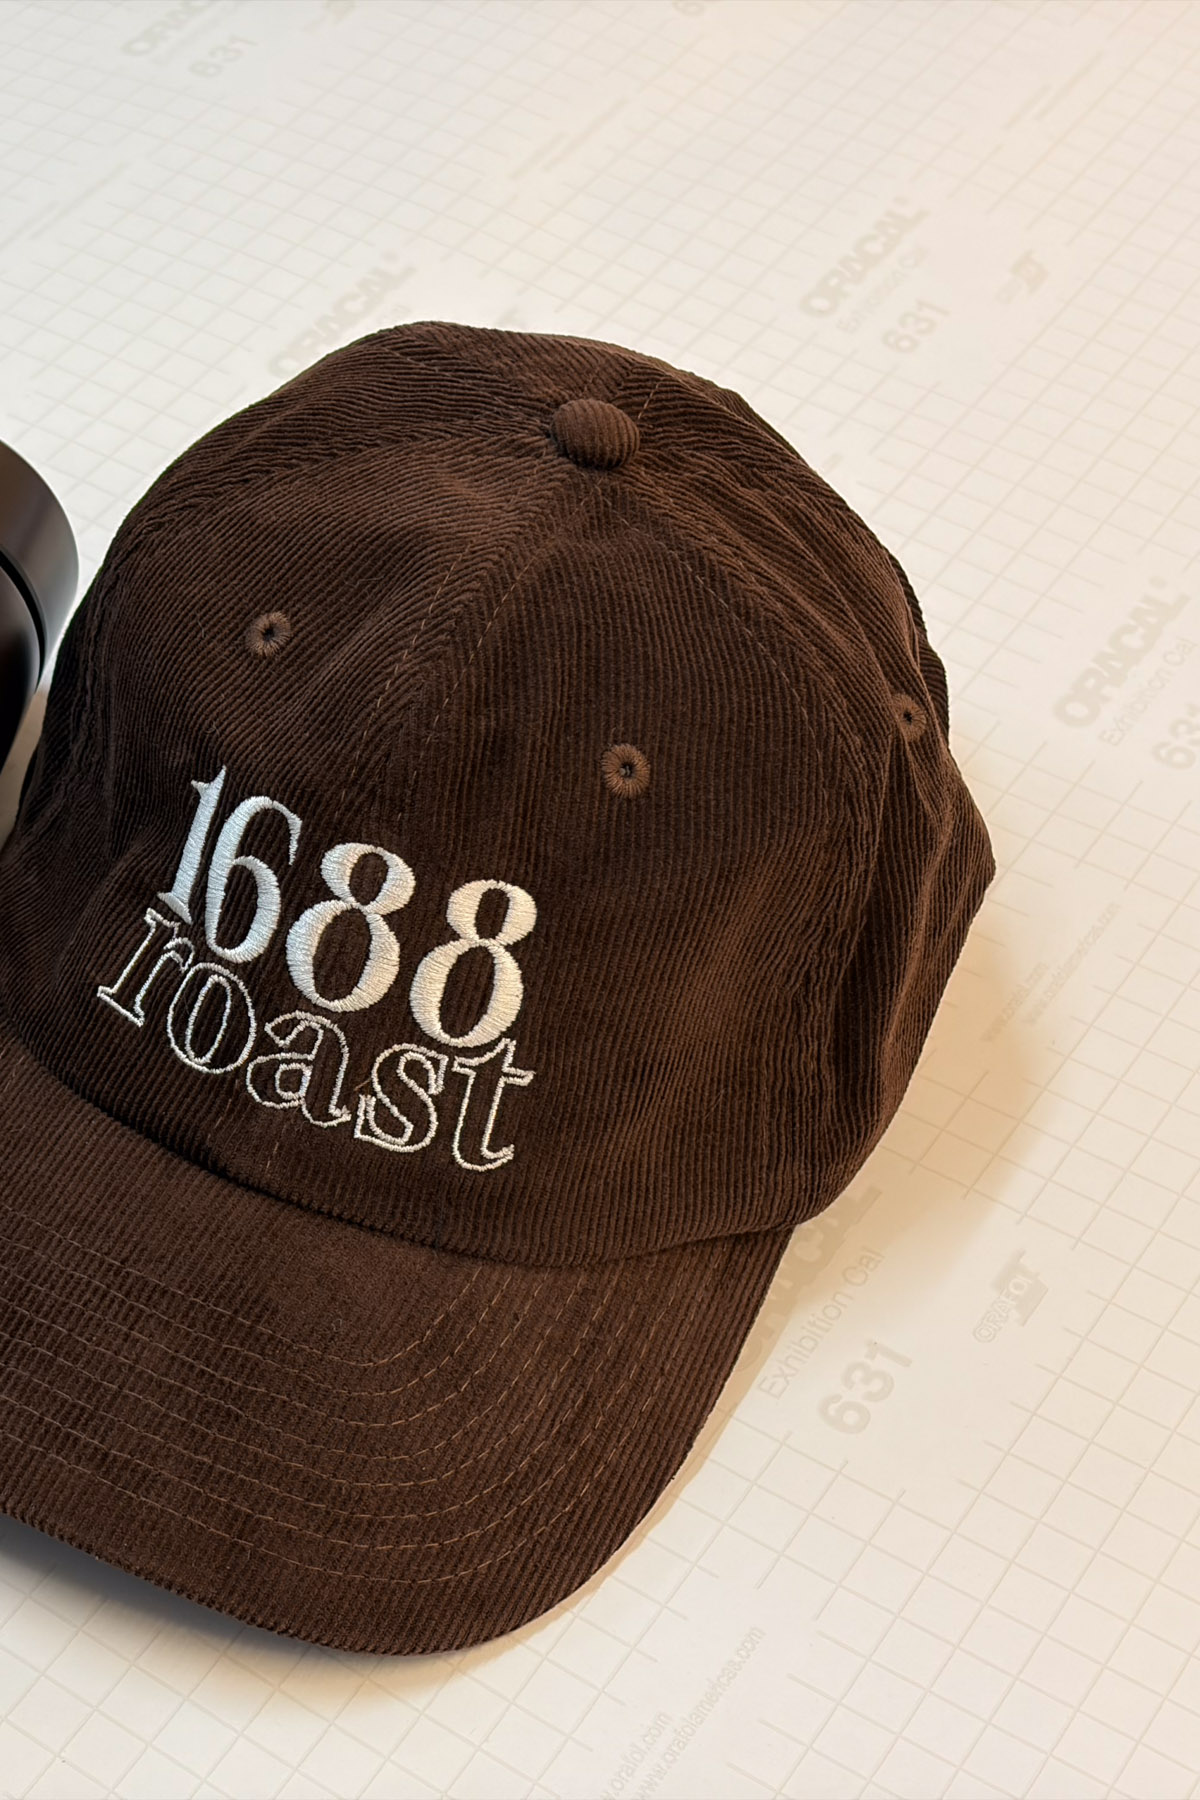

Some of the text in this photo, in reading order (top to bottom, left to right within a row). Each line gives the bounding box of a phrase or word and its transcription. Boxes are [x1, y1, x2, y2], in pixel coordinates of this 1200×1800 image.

[796, 208, 931, 318] ORACAL
[880, 298, 949, 353] 631
[1052, 592, 1193, 728] ORACAL
[156, 764, 538, 1049] 1688
[96, 906, 537, 1172] roast
[756, 1245, 886, 1401] Exhibition Cal
[816, 1338, 913, 1435] 631
